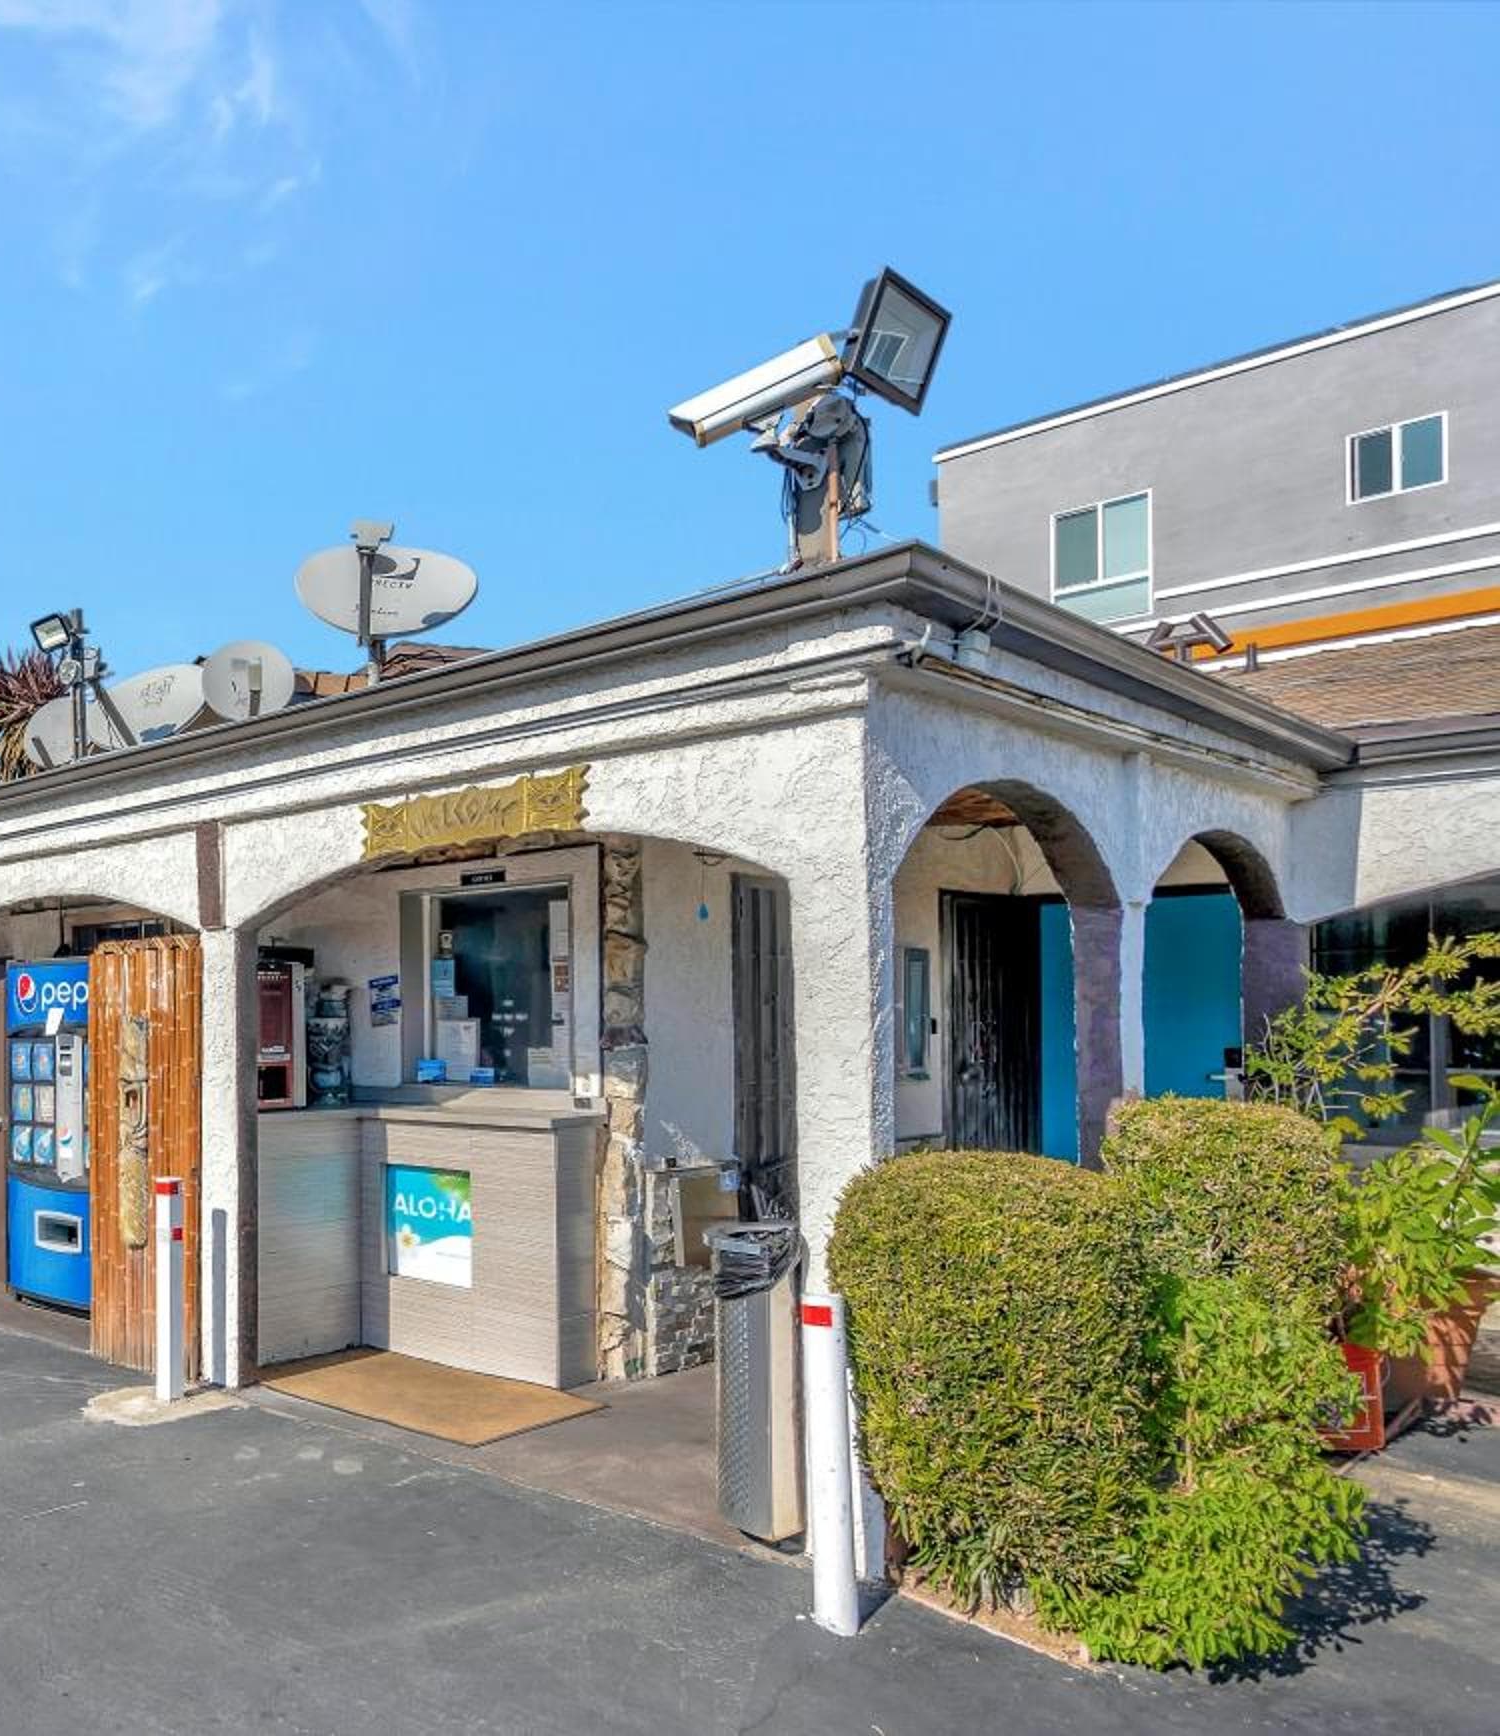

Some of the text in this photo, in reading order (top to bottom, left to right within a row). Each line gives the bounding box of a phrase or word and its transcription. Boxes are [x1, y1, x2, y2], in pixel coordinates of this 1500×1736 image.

[372, 579, 414, 589] RECTV
[41, 980, 89, 1011] pep
[395, 1193, 472, 1223] ALOHA
